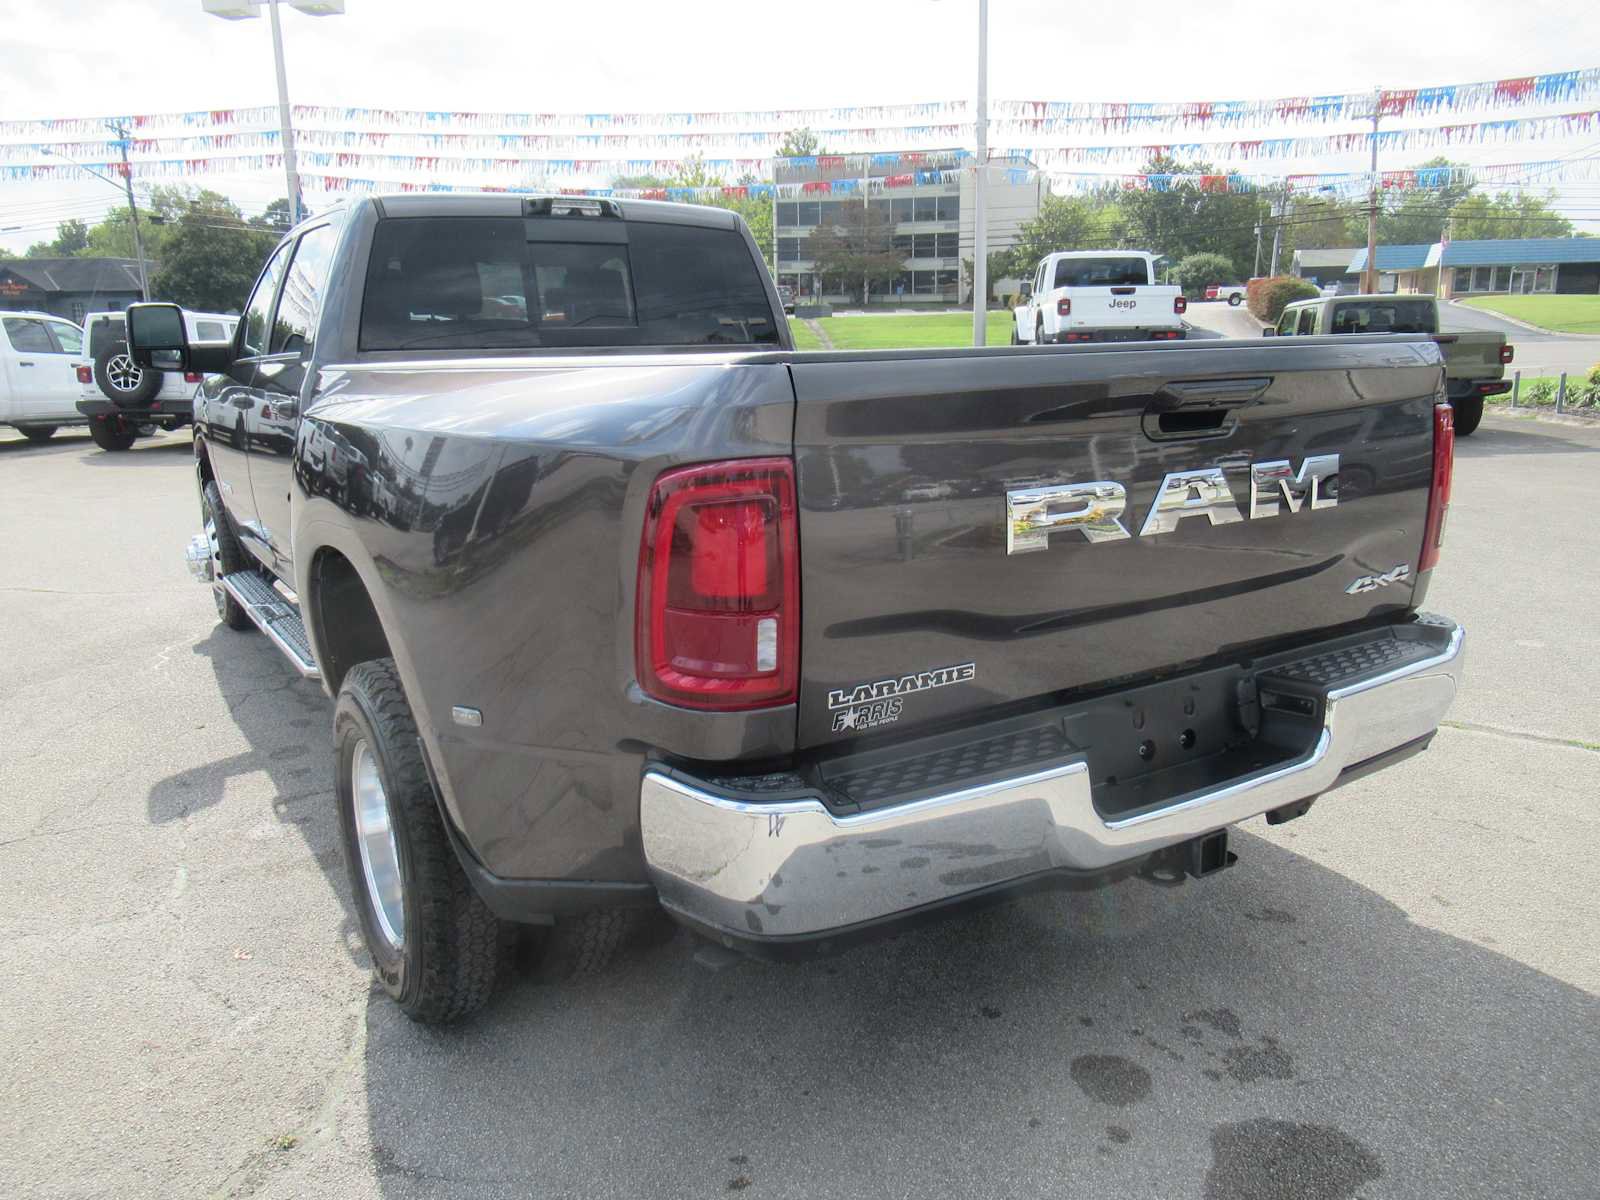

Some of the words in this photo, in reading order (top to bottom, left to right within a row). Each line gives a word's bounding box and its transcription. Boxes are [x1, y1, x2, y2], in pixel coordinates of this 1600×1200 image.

[1108, 299, 1137, 310] Jeep
[1006, 453, 1340, 555] RAM
[828, 663, 976, 709] LARAMIE
[878, 715, 899, 725] PEOPLE
